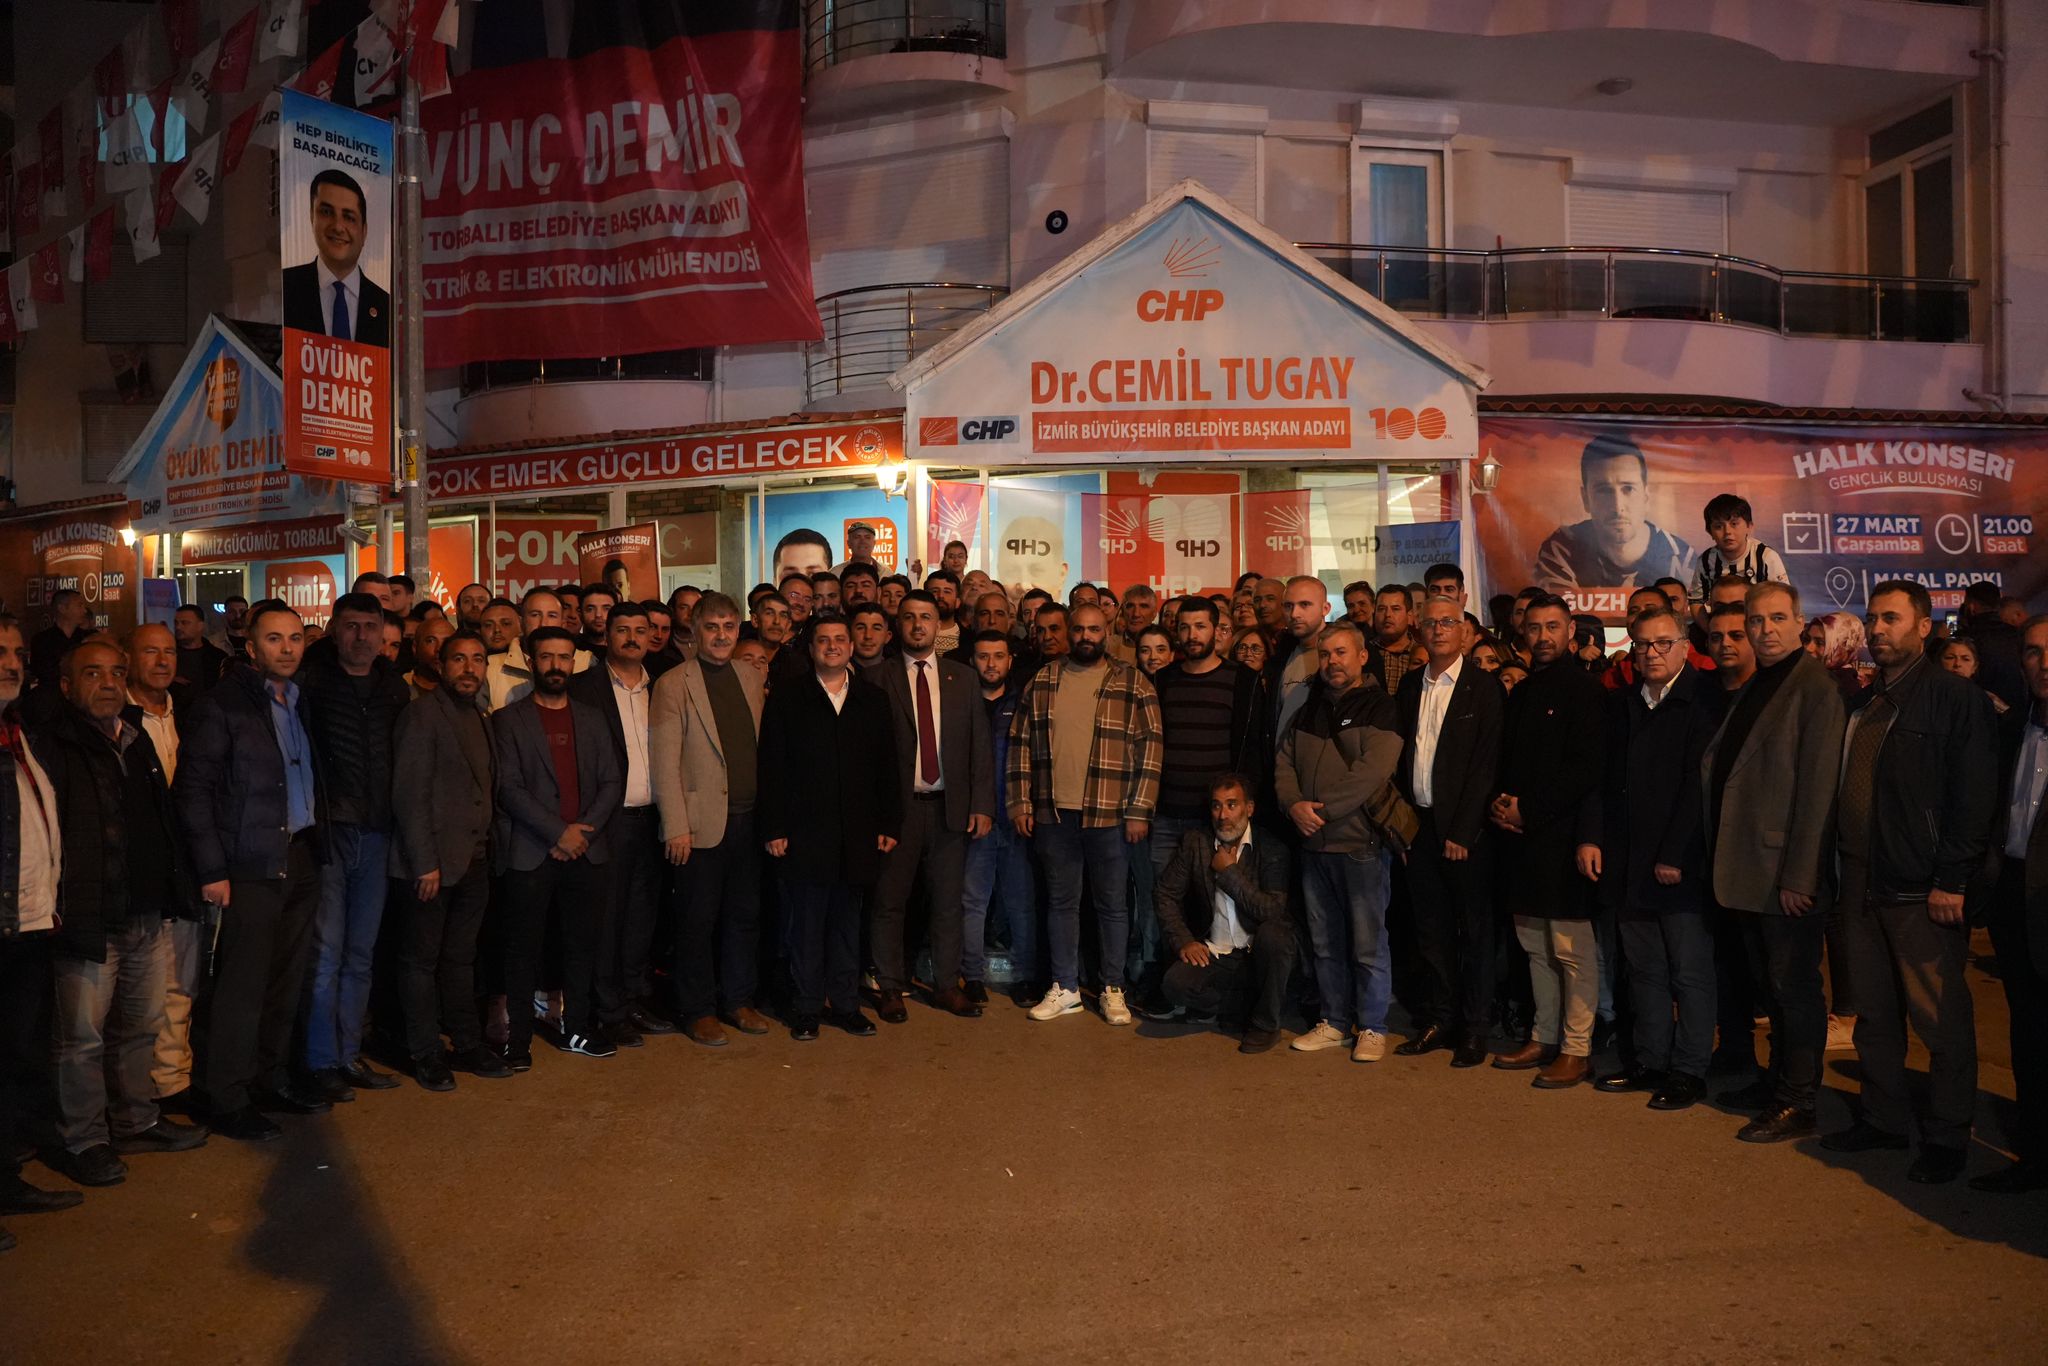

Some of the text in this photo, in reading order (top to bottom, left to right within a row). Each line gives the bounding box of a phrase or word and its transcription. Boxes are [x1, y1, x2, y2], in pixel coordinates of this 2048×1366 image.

[296, 121, 379, 158] HEP BİRLİKTE
[420, 74, 745, 201] VÜNÇ DEMİR
[293, 138, 381, 174] BAŞARACAĞIZ
[429, 197, 741, 251] TORBALI BELEDİYE BAŞKAN ADAYI
[421, 240, 762, 301] KTRİK & ELEKTRONİK MÜHENDİSİ
[1136, 289, 1224, 323] CHP
[300, 337, 374, 388] ÖVÜNÇ
[1031, 347, 1355, 404] Dr.CEMİL TUGAY
[301, 378, 374, 420] DEMİR
[961, 419, 1015, 441] CHP
[1037, 415, 1346, 443] İZMİR BÜYÜKŞEHİR BELEDİYE BAŞKAN ADAYI
[1369, 406, 1447, 440] 100
[166, 442, 221, 481] ÖVÜNÇ
[316, 447, 335, 457] CHP
[342, 447, 371, 466] 100
[425, 434, 849, 497] ÇOK EMEK GÜÇLÜ GELECEK
[1792, 440, 2016, 482] HALK KONSERİ
[263, 475, 287, 487] ADAYI
[1828, 471, 1983, 493] GENÇLİK BULUŞMASI
[143, 500, 161, 516] CHP
[1836, 516, 1921, 534] 27 MART
[1983, 517, 2033, 535] 21.00
[32, 526, 65, 556] HALK
[224, 530, 280, 554] GÜCÜMÜZ
[283, 526, 337, 549] TORBALI
[486, 529, 580, 571] ÇOK
[580, 537, 607, 555] HALK
[1835, 537, 1921, 554] Çarşamba
[1986, 537, 2025, 553] Saat
[103, 573, 125, 587] 21.00
[1150, 575, 1203, 600] HEP
[103, 589, 120, 601] Saat
[1561, 590, 1627, 612] ĞUZH
[95, 615, 109, 627] RKI
